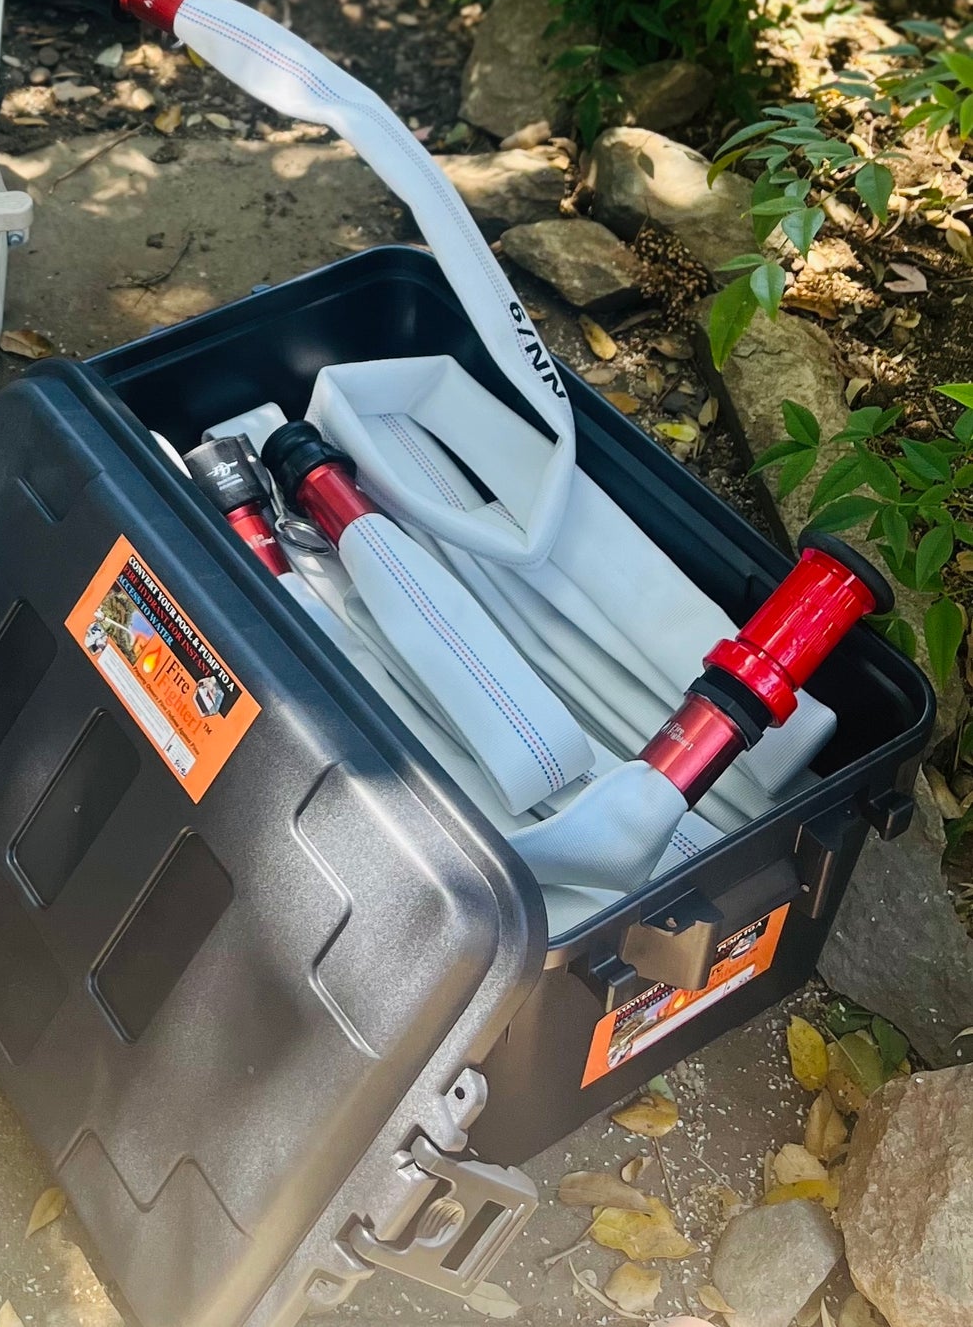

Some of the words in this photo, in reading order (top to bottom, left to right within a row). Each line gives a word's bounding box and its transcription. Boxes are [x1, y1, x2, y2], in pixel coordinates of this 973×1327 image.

[116, 572, 142, 606] ACCESS
[138, 600, 151, 618] TO
[148, 612, 173, 646] WATER
[122, 564, 139, 586] FIRE
[137, 582, 169, 624] HYDRANT
[167, 621, 183, 641] FOR
[180, 637, 211, 678] INSTANT
[127, 555, 158, 595] CONVERT
[156, 591, 177, 618] YOUR
[174, 614, 194, 641] POOL
[191, 636, 200, 648] &
[198, 644, 219, 671] PUMP
[216, 667, 229, 684] TO
[226, 680, 235, 692] A
[166, 660, 190, 695] Fire
[667, 722, 684, 735] Fire
